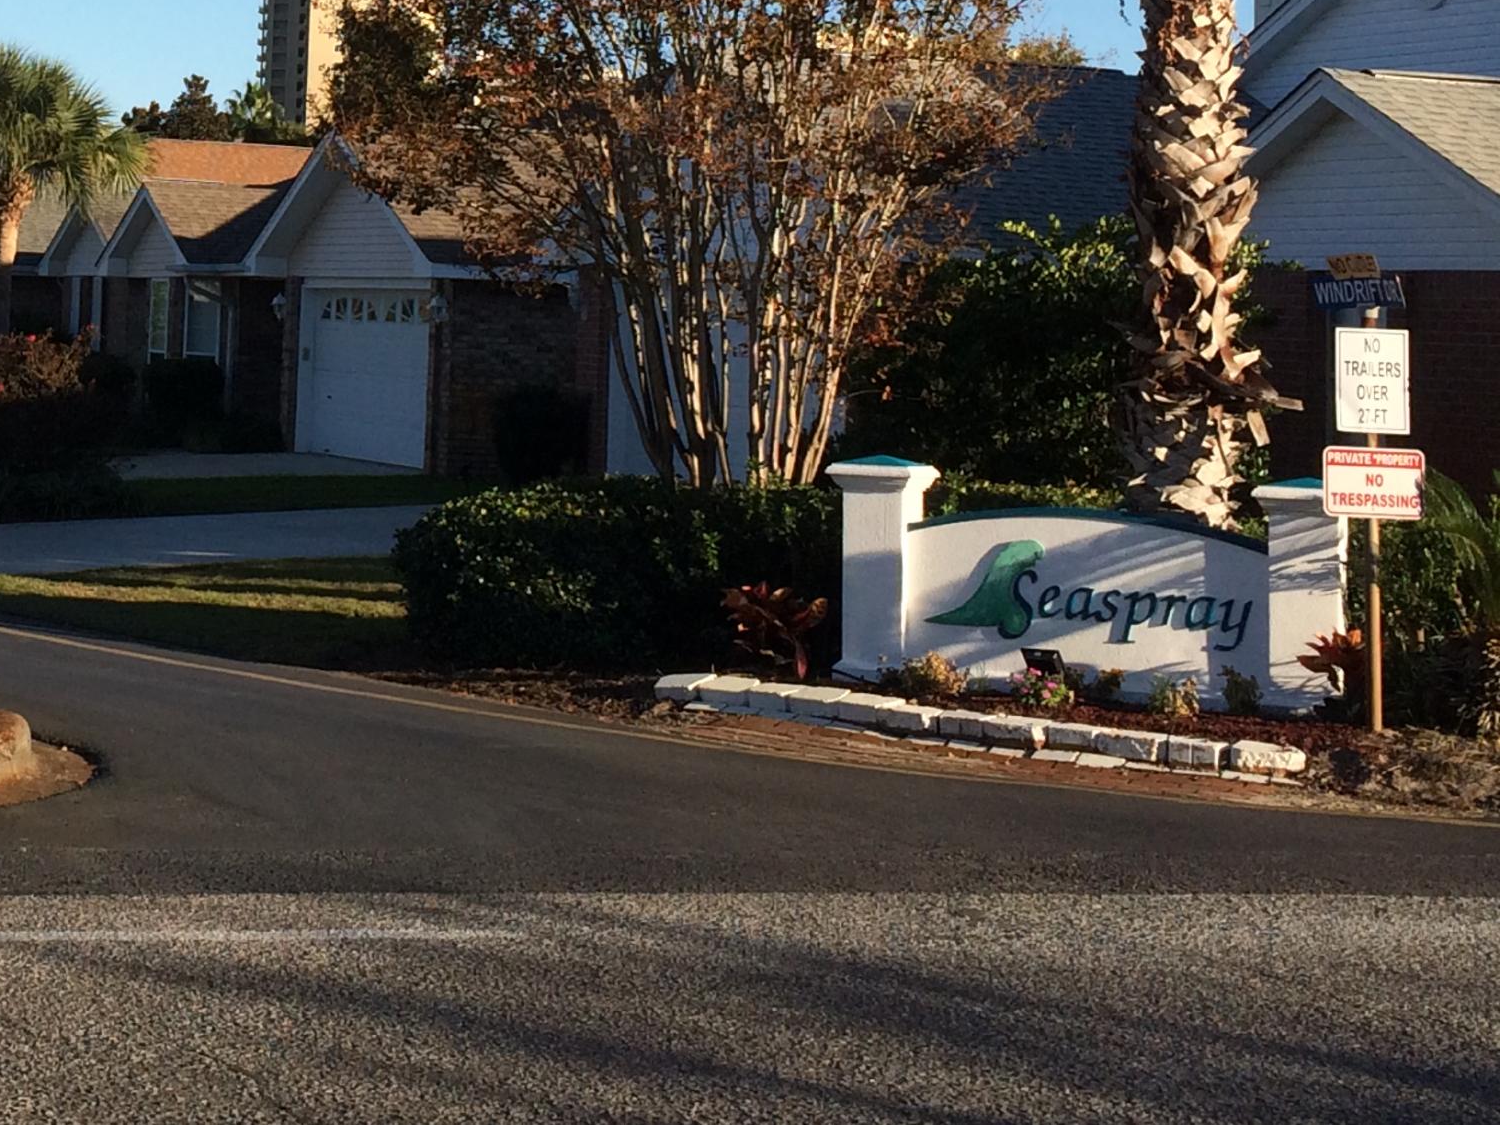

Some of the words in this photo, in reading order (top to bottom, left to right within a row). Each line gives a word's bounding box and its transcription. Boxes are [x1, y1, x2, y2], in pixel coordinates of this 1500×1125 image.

[1314, 279, 1384, 305] WINDRIFT
[1364, 337, 1381, 354] NO
[1344, 360, 1402, 379] TRAILERS
[1356, 384, 1389, 401] OVER
[1374, 408, 1388, 425] FT
[1327, 451, 1372, 465] PRIVATE
[1372, 454, 1420, 468] PROPERTY
[1365, 473, 1384, 487] NO
[1331, 492, 1420, 509] TRESPASSING
[997, 569, 1254, 652] Seaspray
